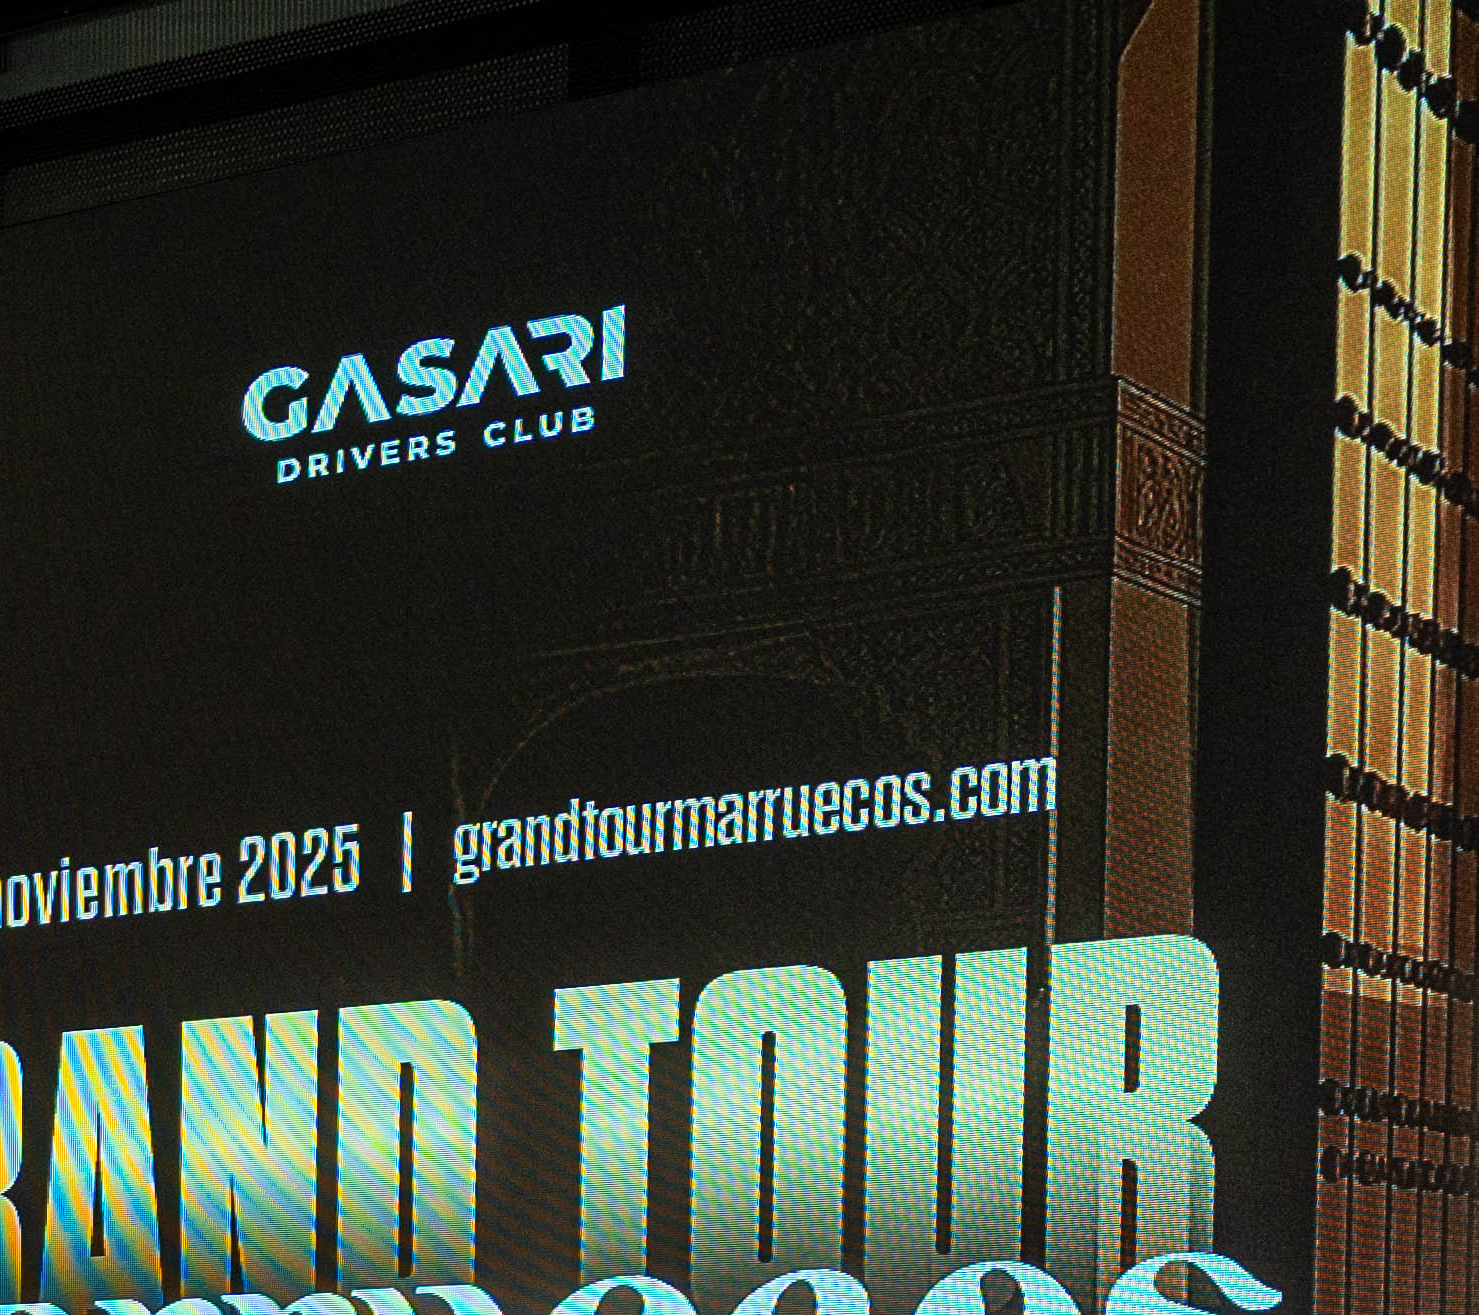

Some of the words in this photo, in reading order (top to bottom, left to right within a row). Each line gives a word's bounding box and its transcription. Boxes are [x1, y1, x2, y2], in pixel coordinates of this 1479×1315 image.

[241, 304, 625, 442] GASARI
[276, 430, 457, 484] DRIVERS
[482, 406, 596, 448] CLUB
[237, 823, 360, 904] 2025
[452, 757, 1059, 886] grandtourmarruecos.com
[554, 934, 1219, 1315] TOUR
